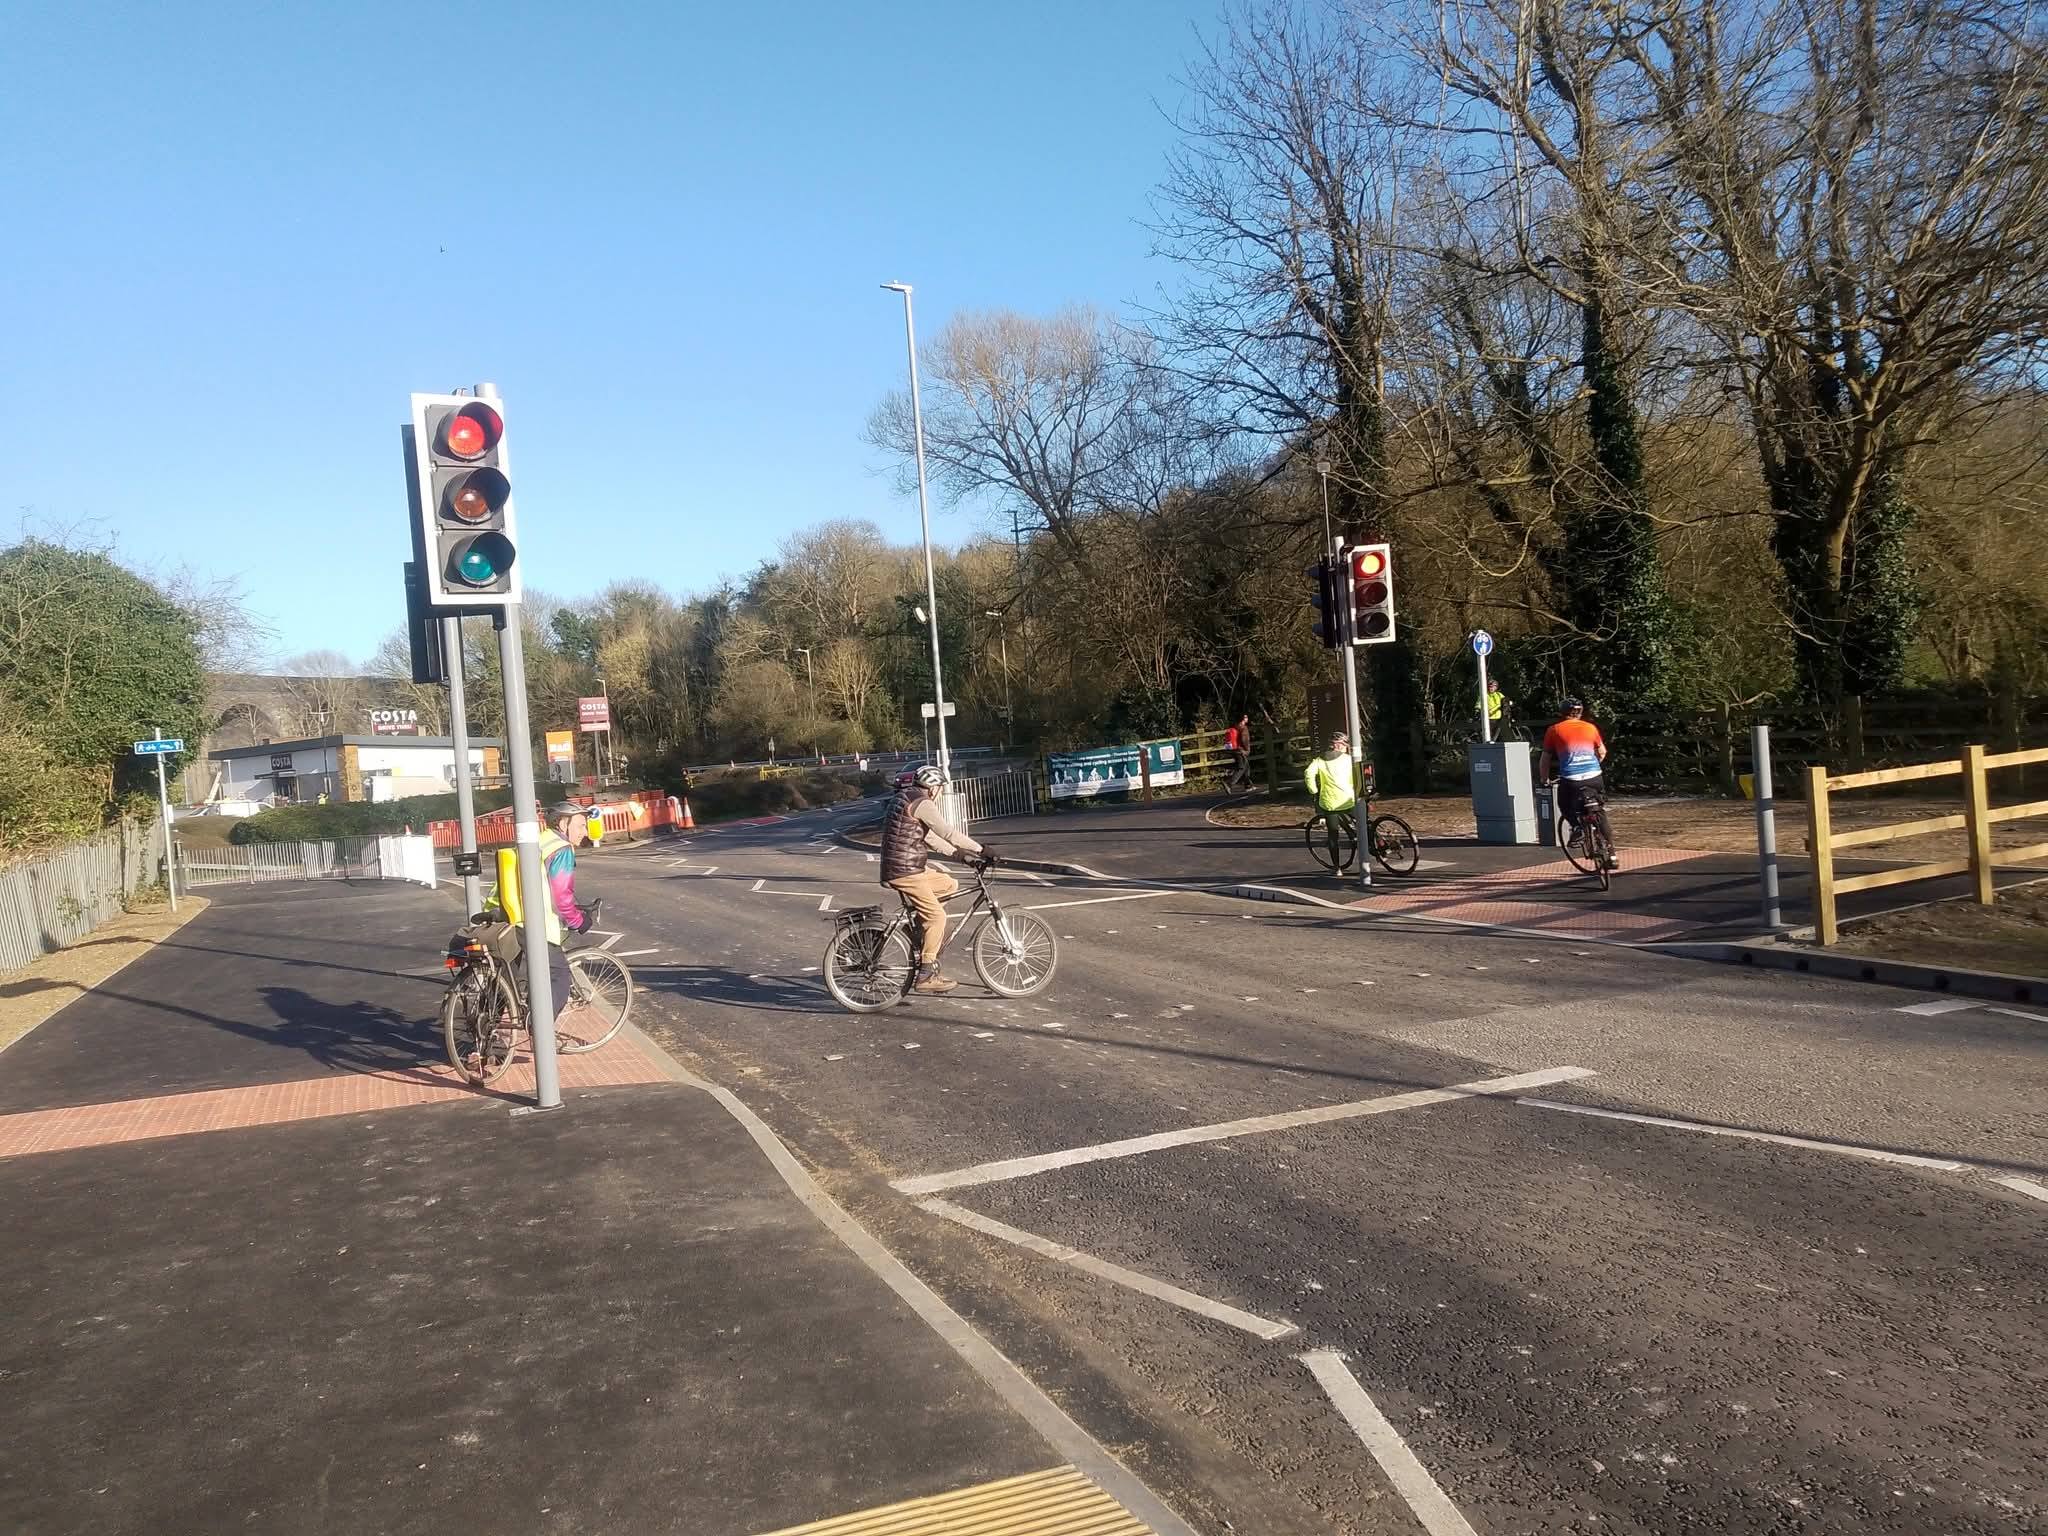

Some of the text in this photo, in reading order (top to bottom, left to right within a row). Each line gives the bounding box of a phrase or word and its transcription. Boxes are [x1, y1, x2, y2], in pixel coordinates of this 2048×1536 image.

[581, 703, 608, 711] COSTA
[371, 709, 418, 723] COSTA
[271, 756, 291, 769] COSTA
